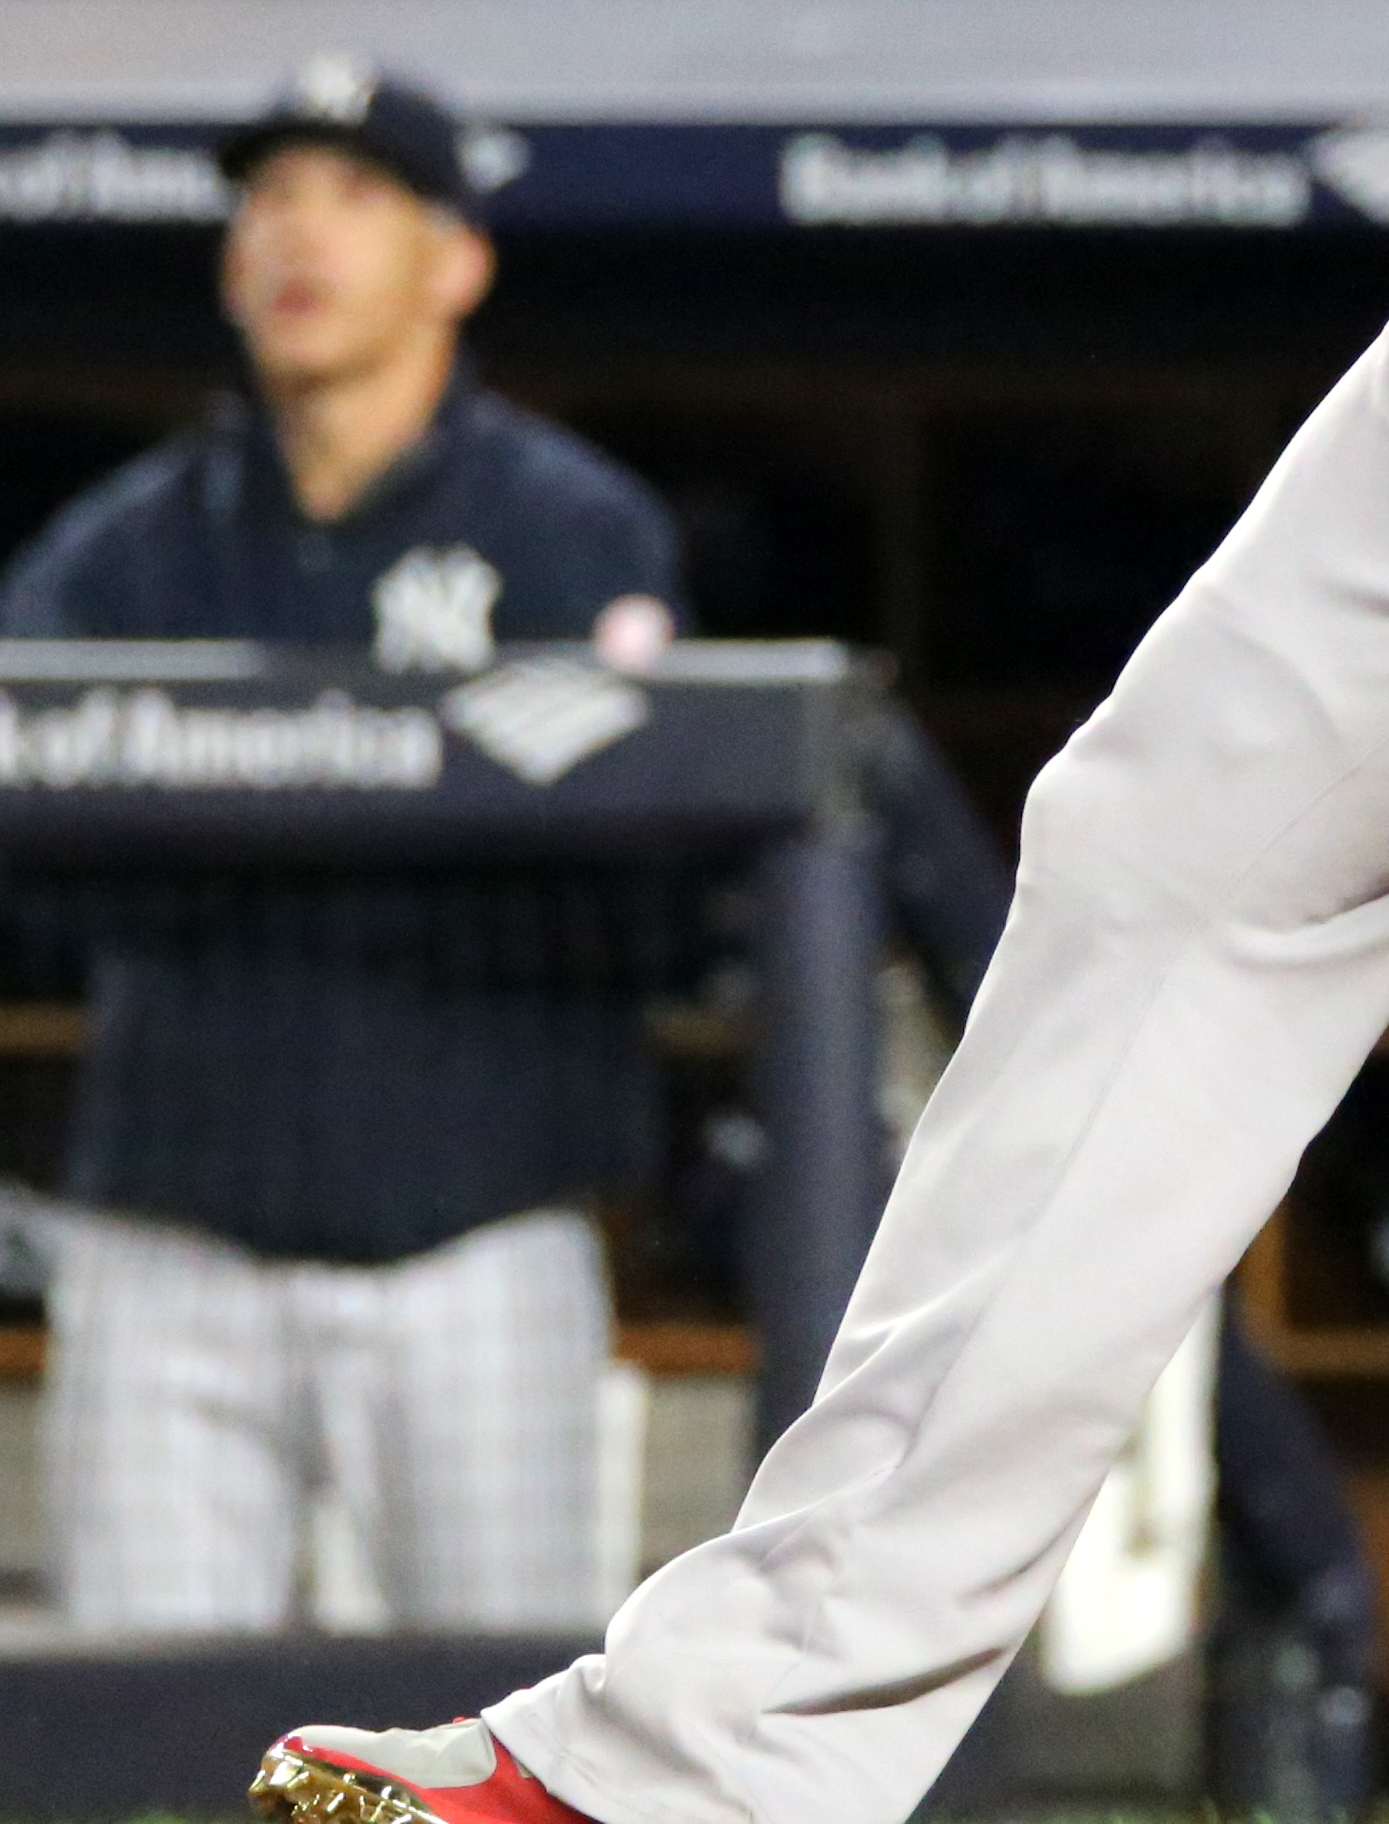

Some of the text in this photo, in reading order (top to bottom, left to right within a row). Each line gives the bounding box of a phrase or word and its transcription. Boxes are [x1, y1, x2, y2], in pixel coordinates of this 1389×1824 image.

[778, 133, 1310, 226] Bank of America
[25, 686, 118, 788] of
[120, 687, 442, 789] America
